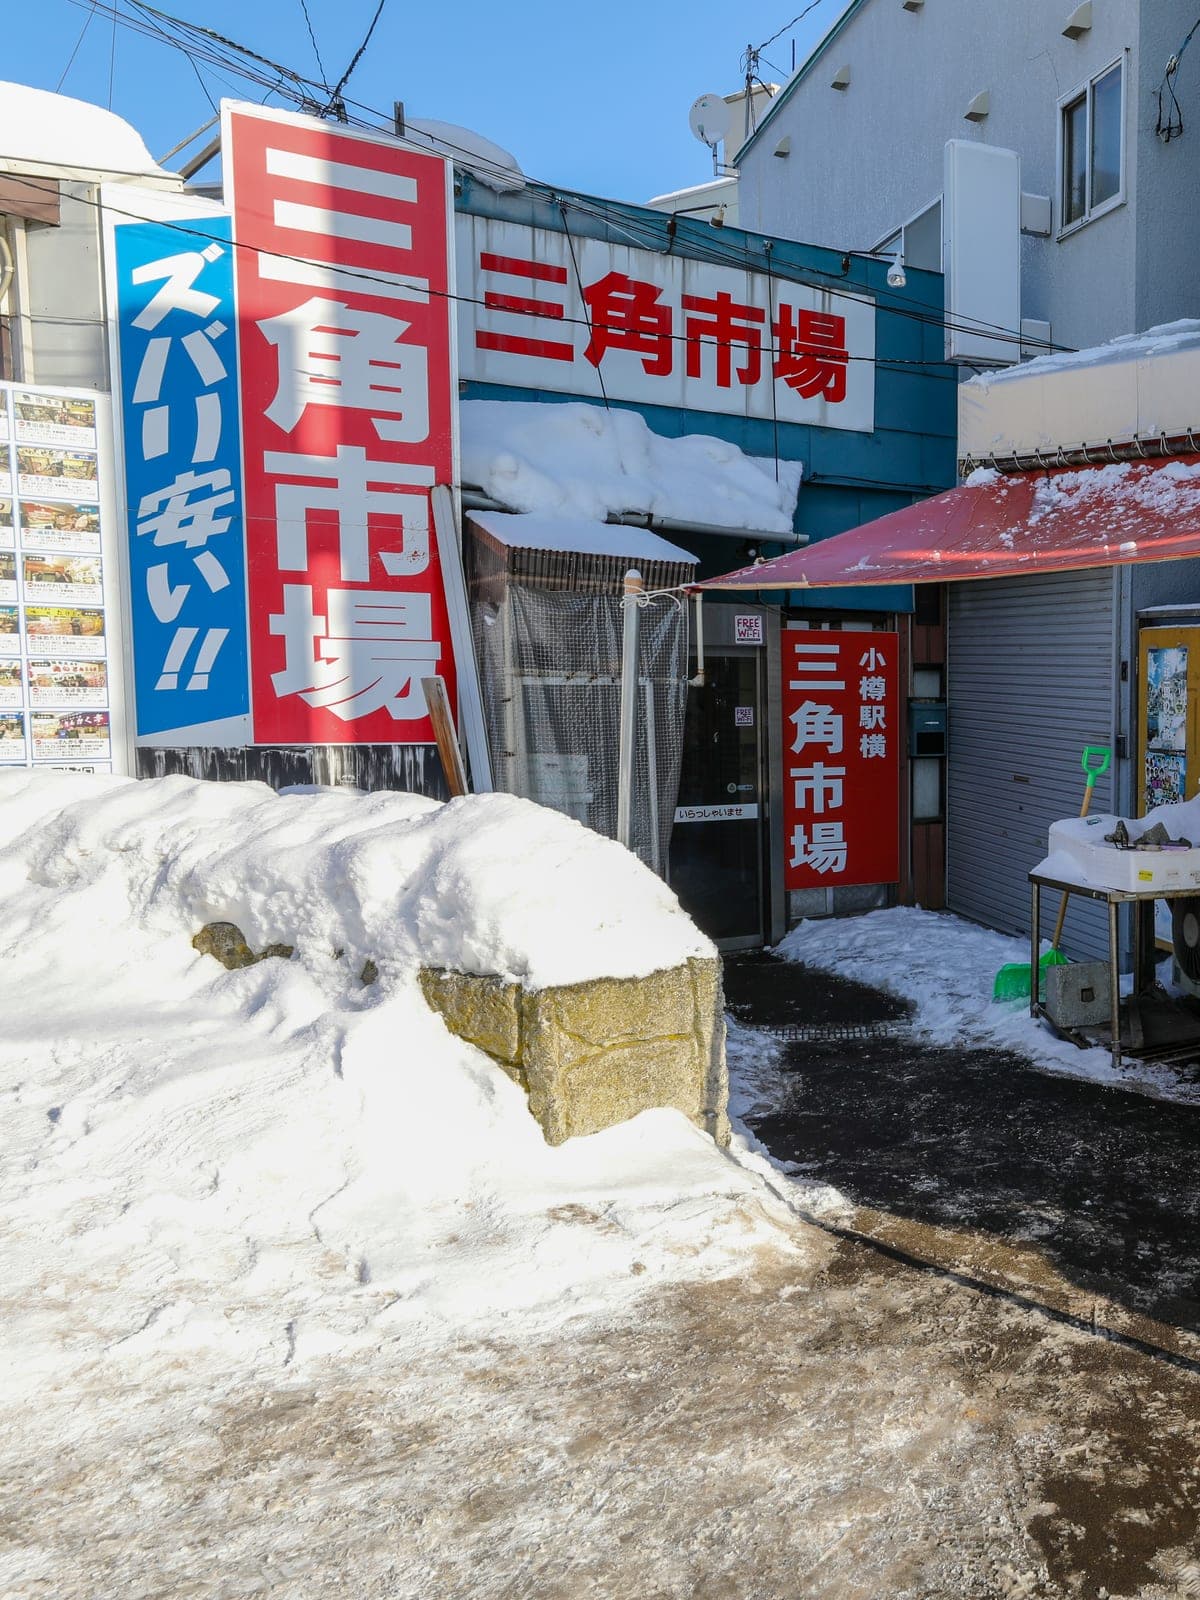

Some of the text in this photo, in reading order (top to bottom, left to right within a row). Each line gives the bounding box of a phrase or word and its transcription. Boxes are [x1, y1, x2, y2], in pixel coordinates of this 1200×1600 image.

[476, 250, 849, 404] 三角市場
[254, 146, 442, 724] 三角市場
[737, 618, 759, 628] FREE
[789, 644, 847, 874] 三角市場
[859, 647, 887, 758] 小樽駅横
[679, 808, 743, 818] いらっしゃいませ
